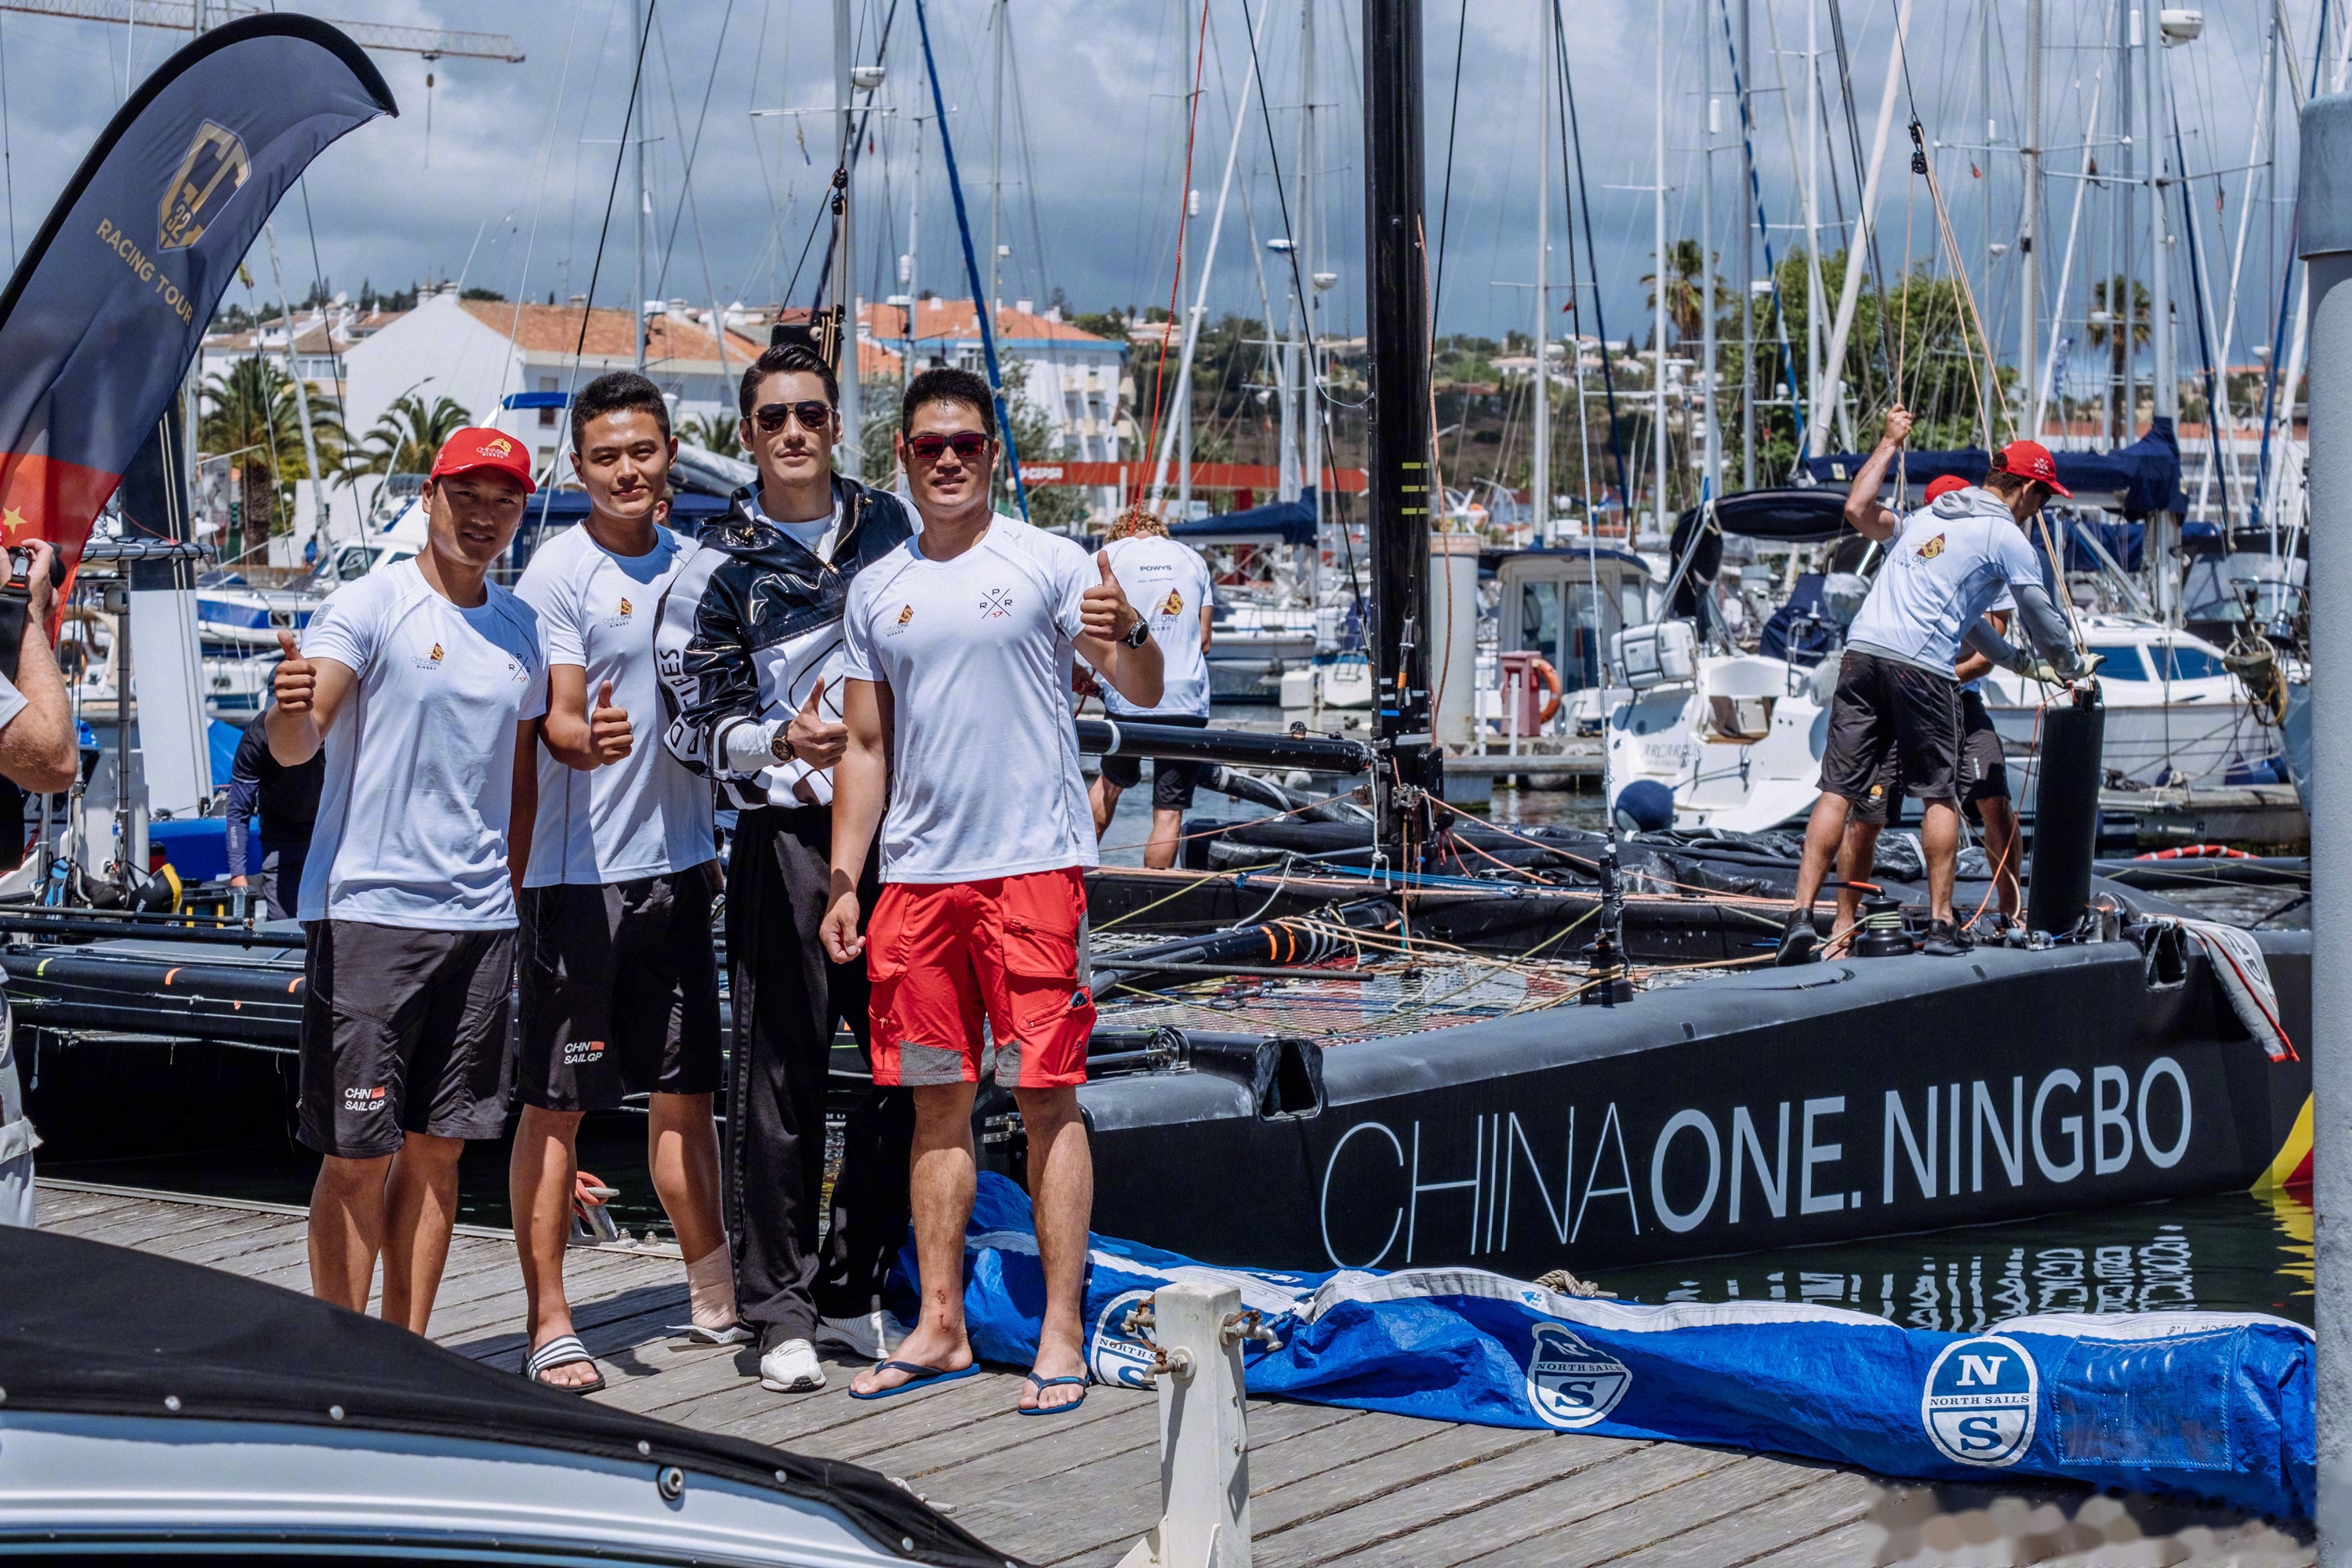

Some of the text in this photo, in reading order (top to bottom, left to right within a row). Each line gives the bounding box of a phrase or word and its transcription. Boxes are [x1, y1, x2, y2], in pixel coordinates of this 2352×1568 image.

[165, 203, 191, 241] 32
[96, 218, 193, 326] RACING TOUR
[564, 1041, 591, 1053] CHN
[345, 1087, 372, 1100] CHN
[1883, 1056, 2192, 1204] NINGBO
[1099, 1338, 1146, 1358] NORTH
[1536, 1363, 1624, 1372] NORTH SAILS
[1955, 1354, 2009, 1387] N
[1555, 1381, 1597, 1408] S
[1929, 1395, 2031, 1406] NORTH SAILS
[1958, 1416, 2003, 1451] S
